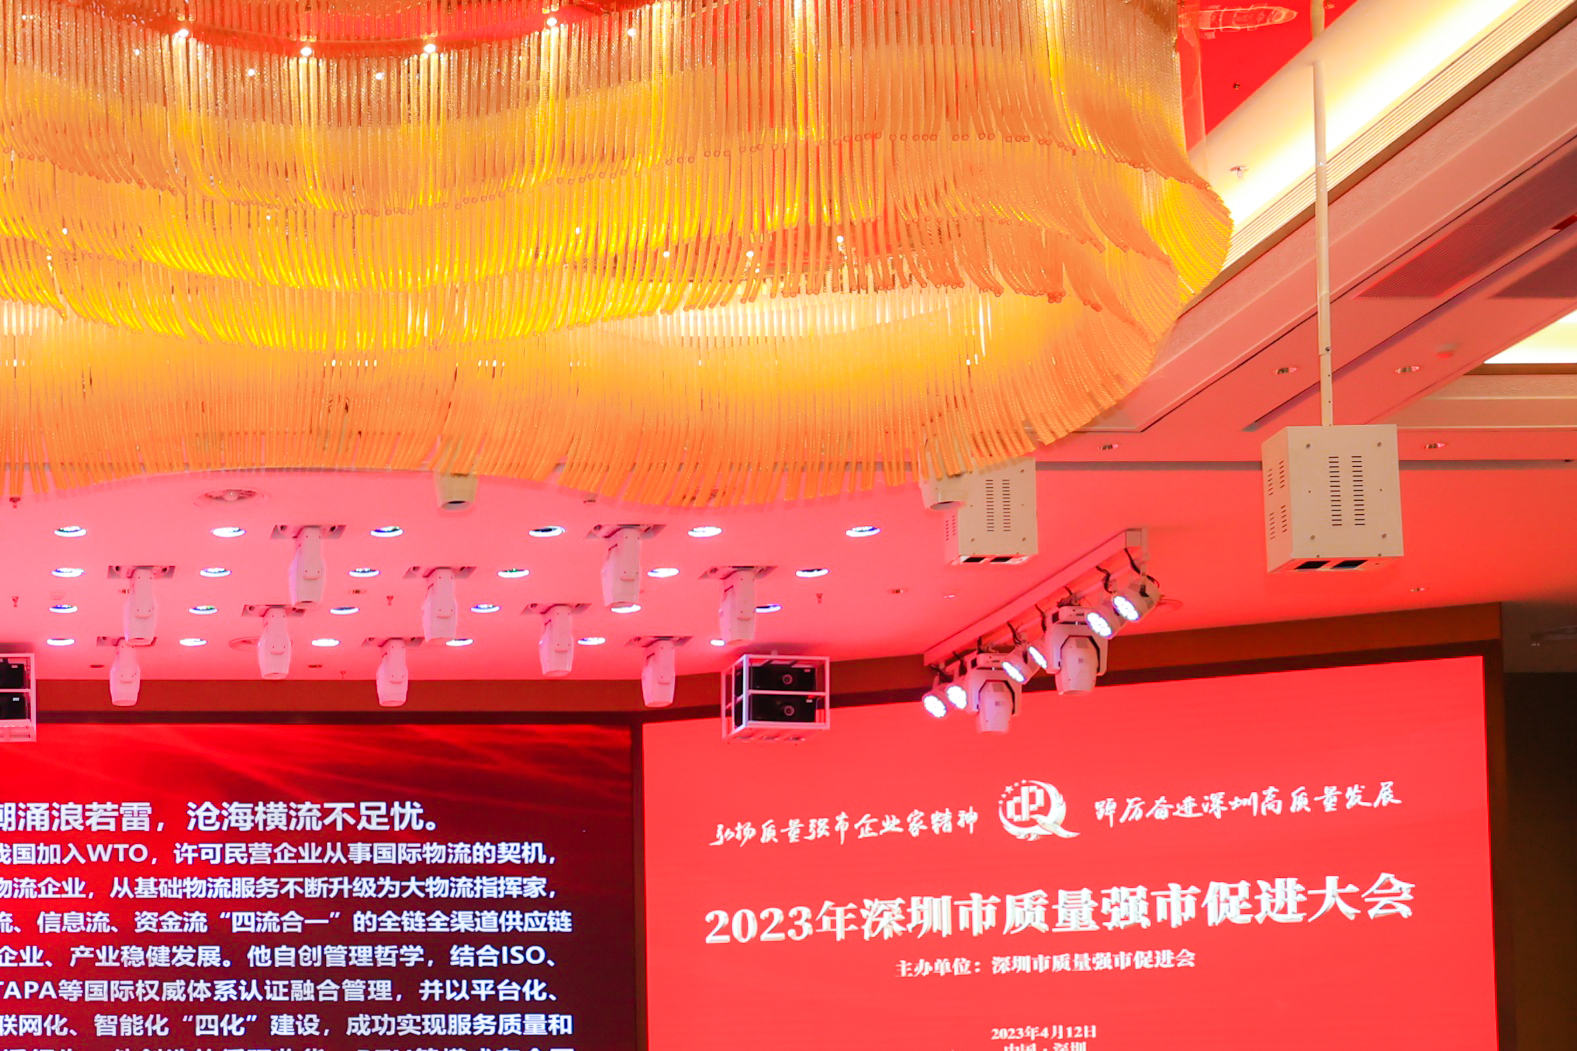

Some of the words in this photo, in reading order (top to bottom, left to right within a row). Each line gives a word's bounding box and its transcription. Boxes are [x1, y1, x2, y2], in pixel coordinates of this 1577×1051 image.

[704, 871, 1416, 945] 2023年深圳市质量强市促进大会
[895, 948, 1196, 978] 主办单位：深圳市质量强市促进会
[991, 1025, 1097, 1042] 2023年4月12日
